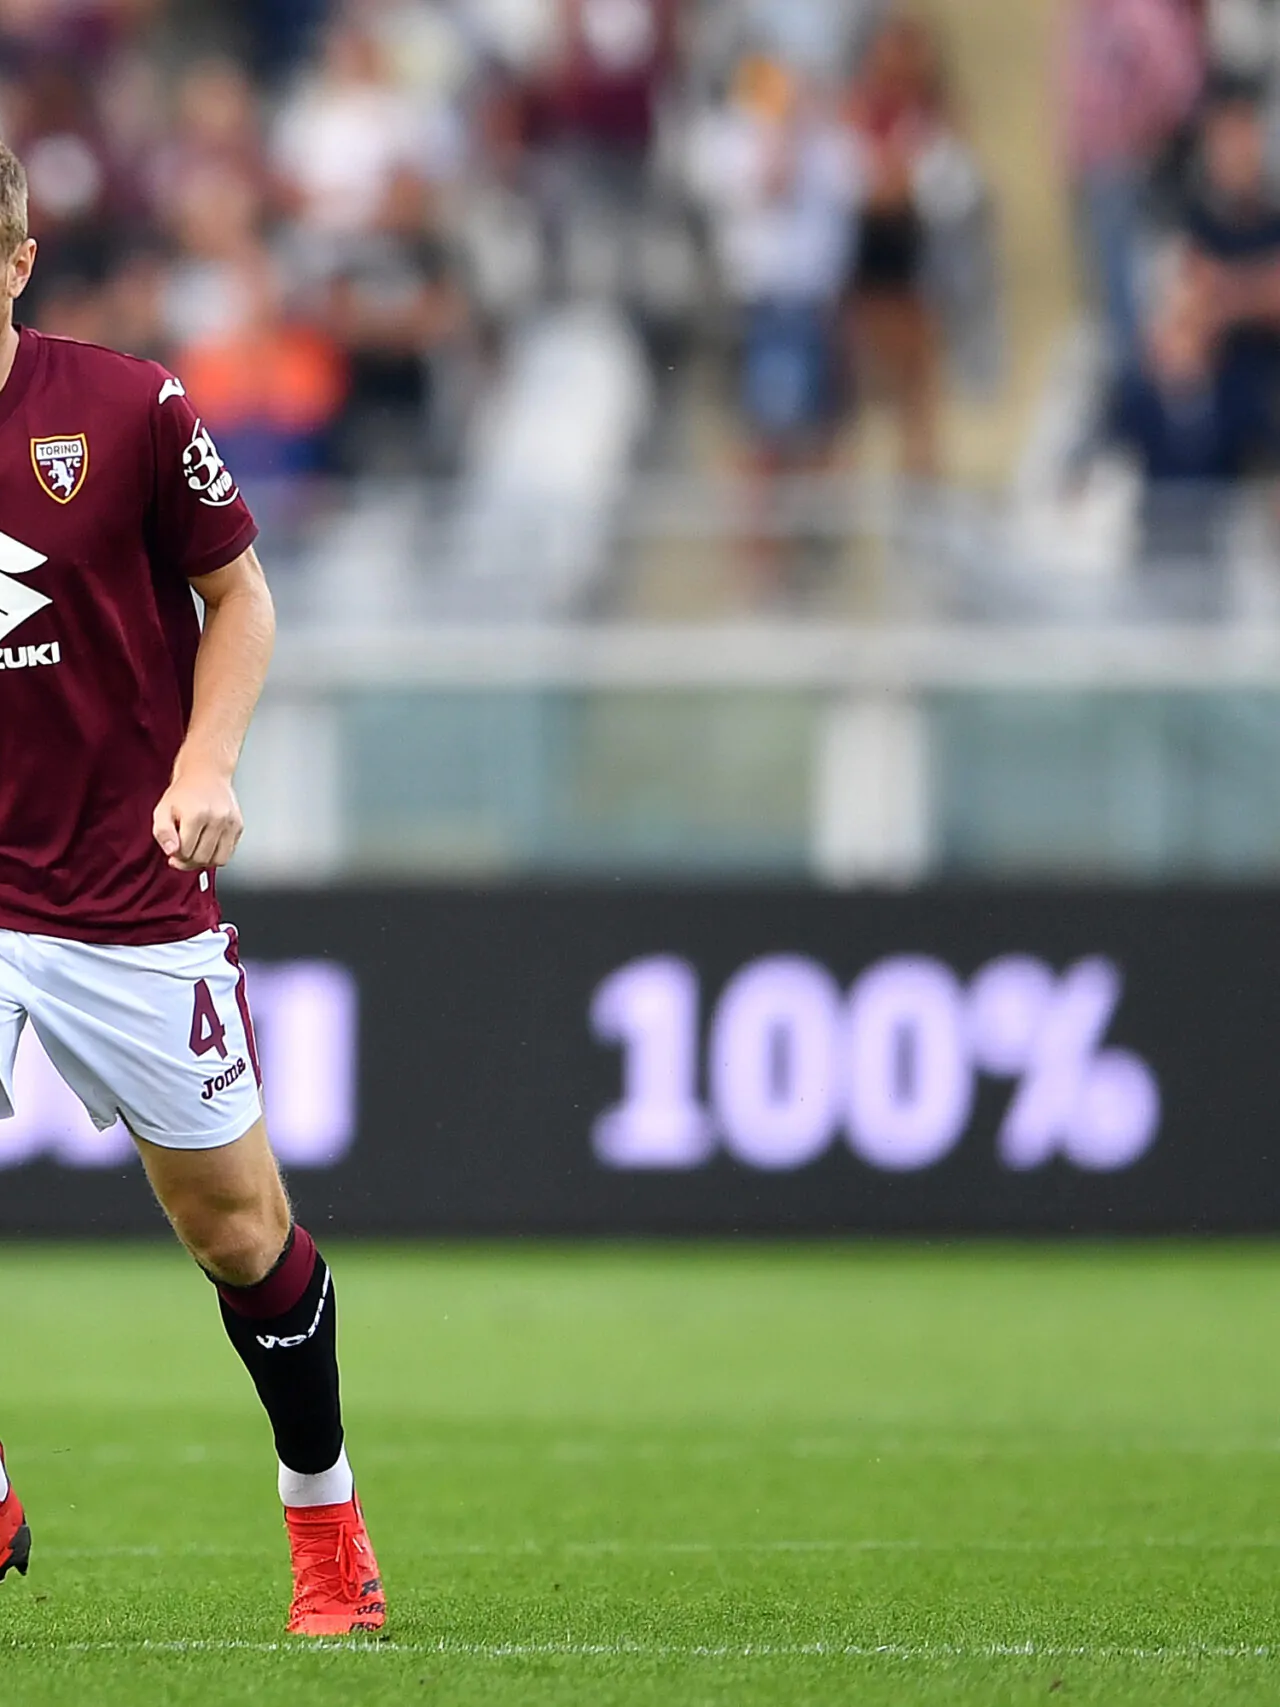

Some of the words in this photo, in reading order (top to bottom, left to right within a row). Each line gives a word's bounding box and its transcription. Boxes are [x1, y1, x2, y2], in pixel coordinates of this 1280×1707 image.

[39, 443, 79, 457] TORINO
[188, 977, 228, 1061] 4
[200, 1057, 246, 1100] Joma
[590, 954, 1159, 1171] 100%
